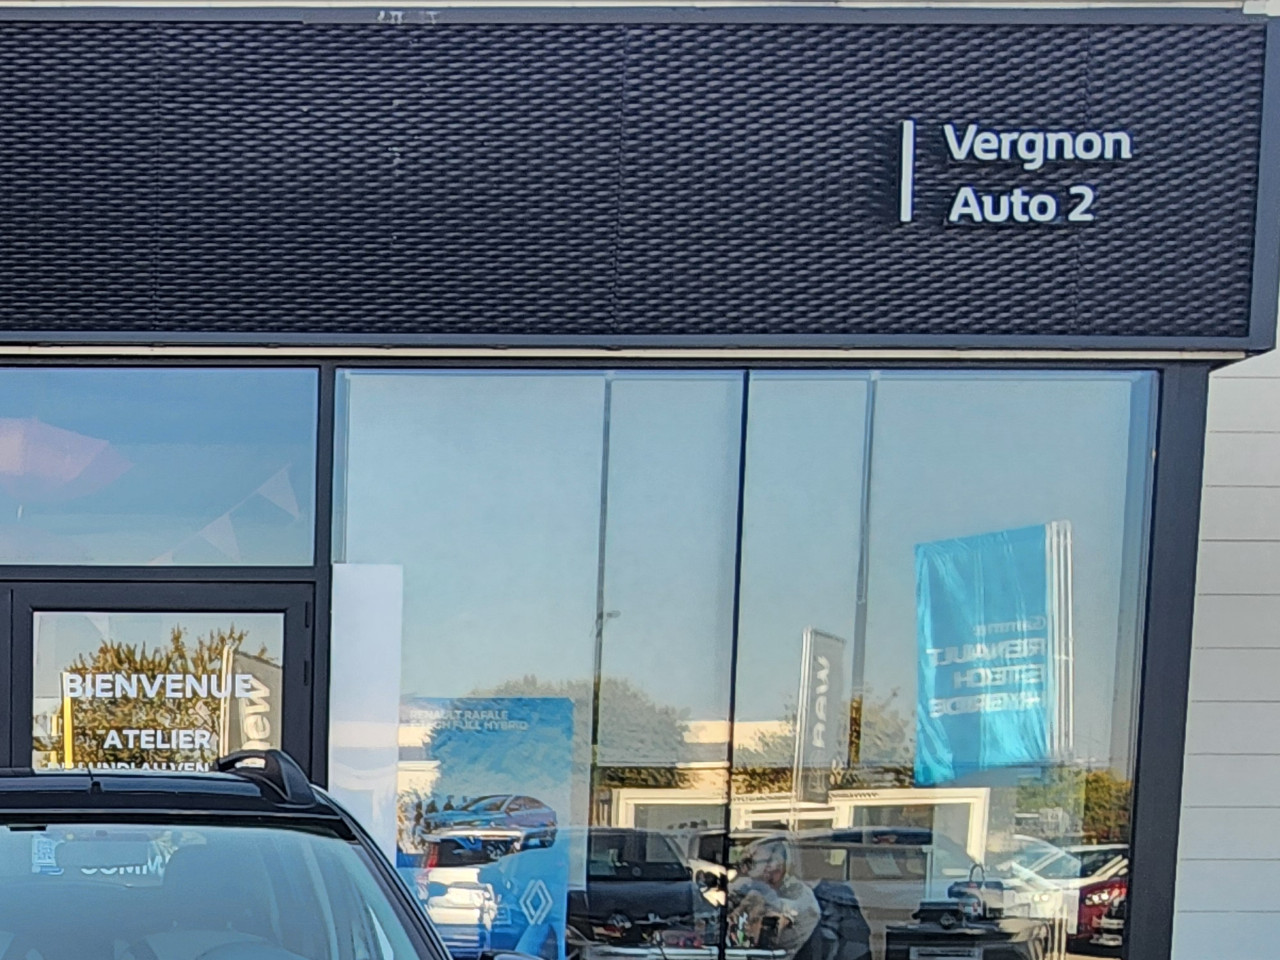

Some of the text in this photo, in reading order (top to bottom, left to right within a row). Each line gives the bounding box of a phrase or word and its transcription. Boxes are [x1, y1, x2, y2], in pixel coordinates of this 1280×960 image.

[943, 124, 1133, 170] Vergnon
[949, 185, 1094, 222] Auto 2
[65, 673, 252, 698] BIENVENUE
[464, 710, 509, 720] RAFALE
[104, 729, 211, 749] ATELIER
